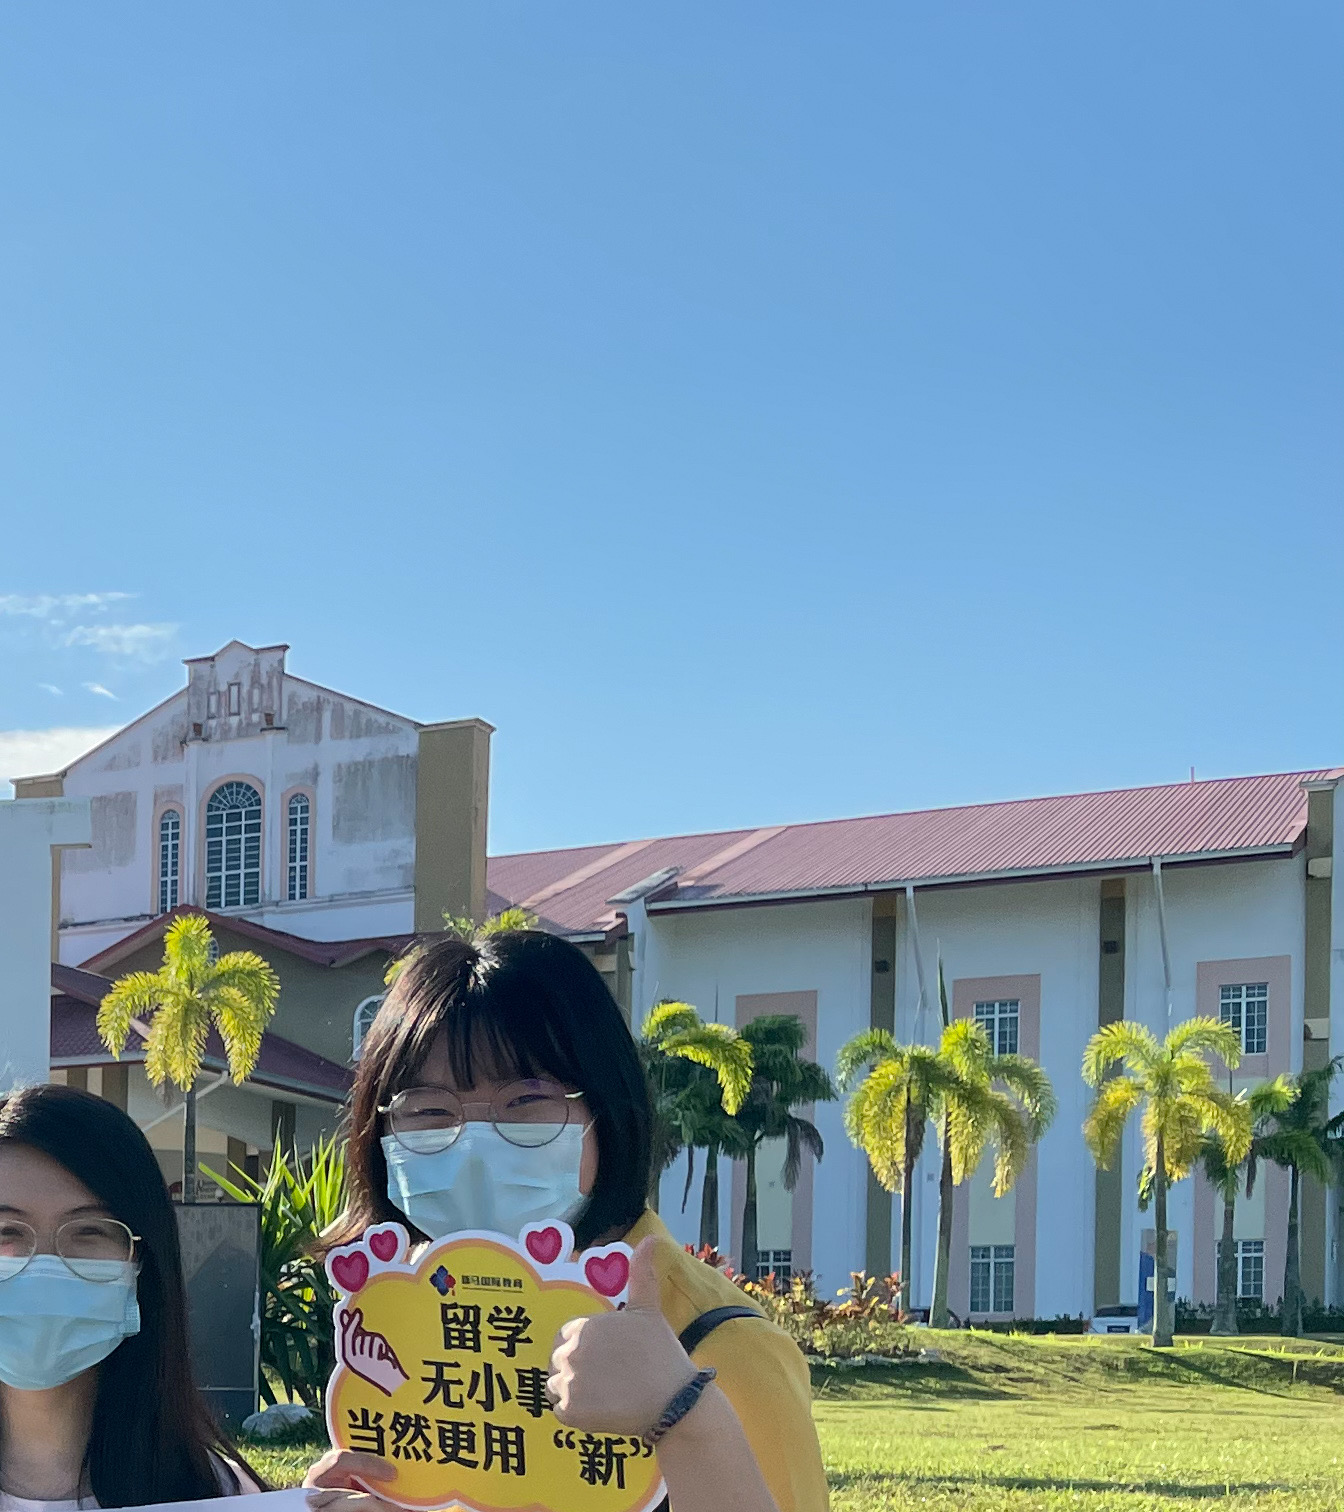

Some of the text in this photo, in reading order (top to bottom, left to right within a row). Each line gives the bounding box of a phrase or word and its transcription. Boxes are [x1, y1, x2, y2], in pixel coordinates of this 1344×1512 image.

[439, 1302, 533, 1357] 留学
[420, 1358, 555, 1418] 无小事
